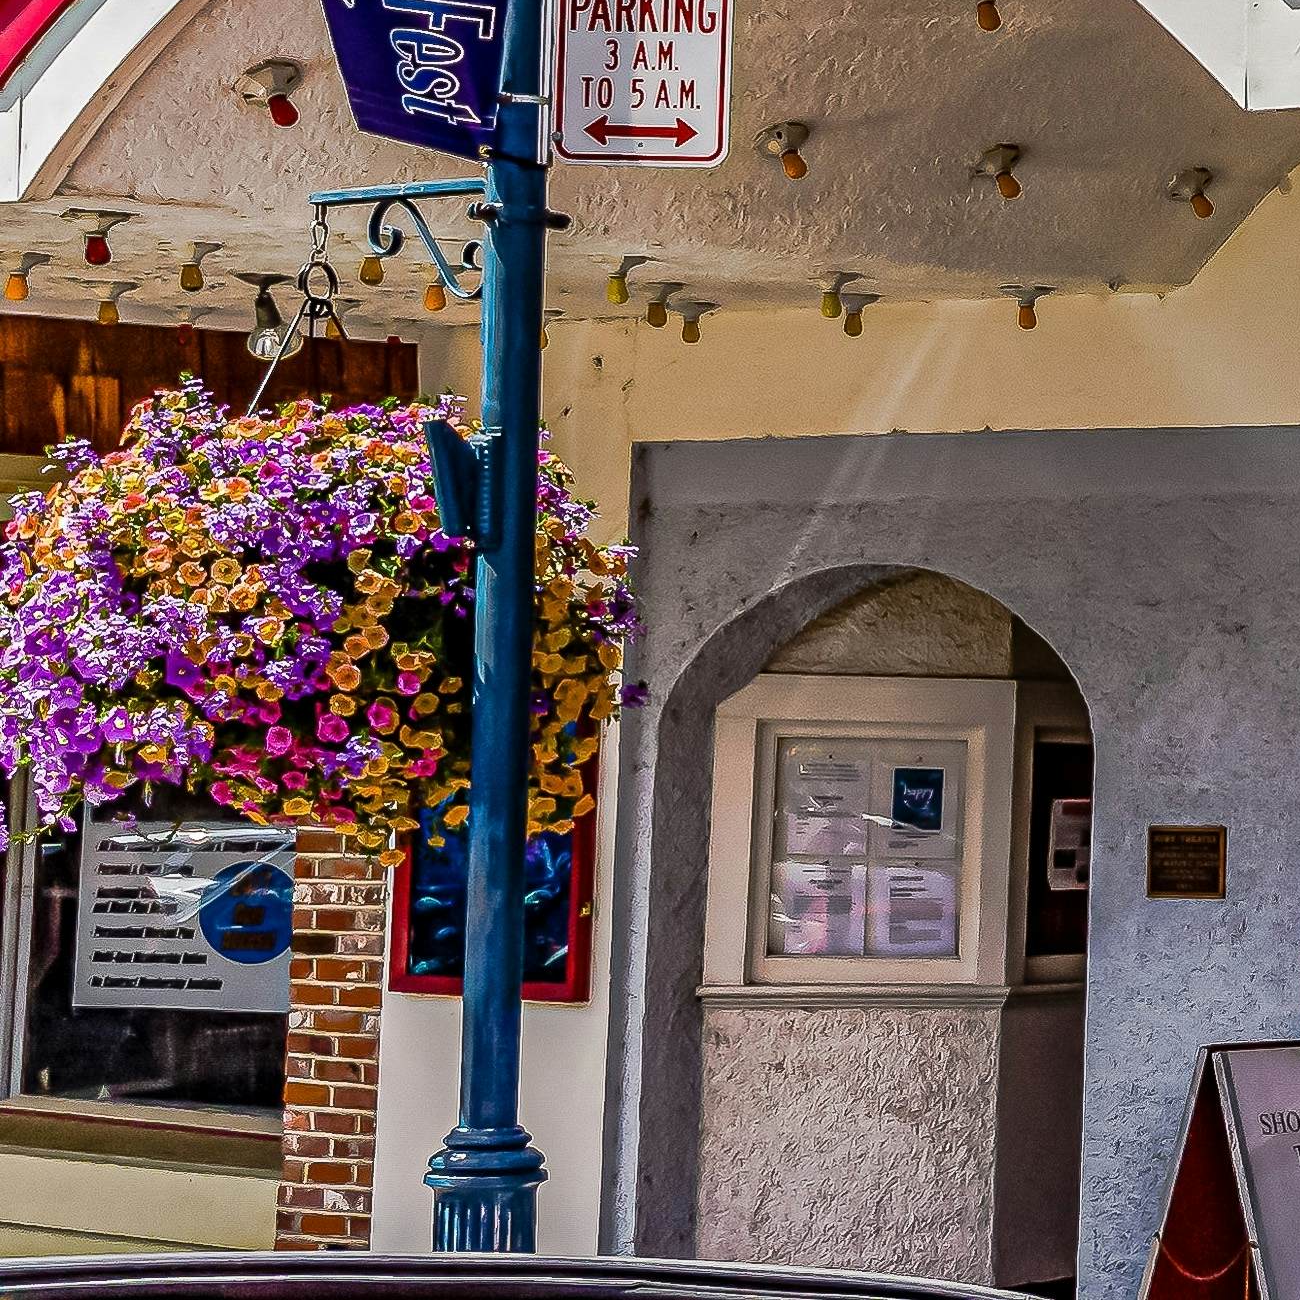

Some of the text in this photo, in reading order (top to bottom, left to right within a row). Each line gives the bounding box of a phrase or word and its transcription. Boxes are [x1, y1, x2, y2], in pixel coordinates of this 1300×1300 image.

[604, 39, 680, 71] 3 A.M.
[582, 76, 701, 109] TO 5 A.M.
